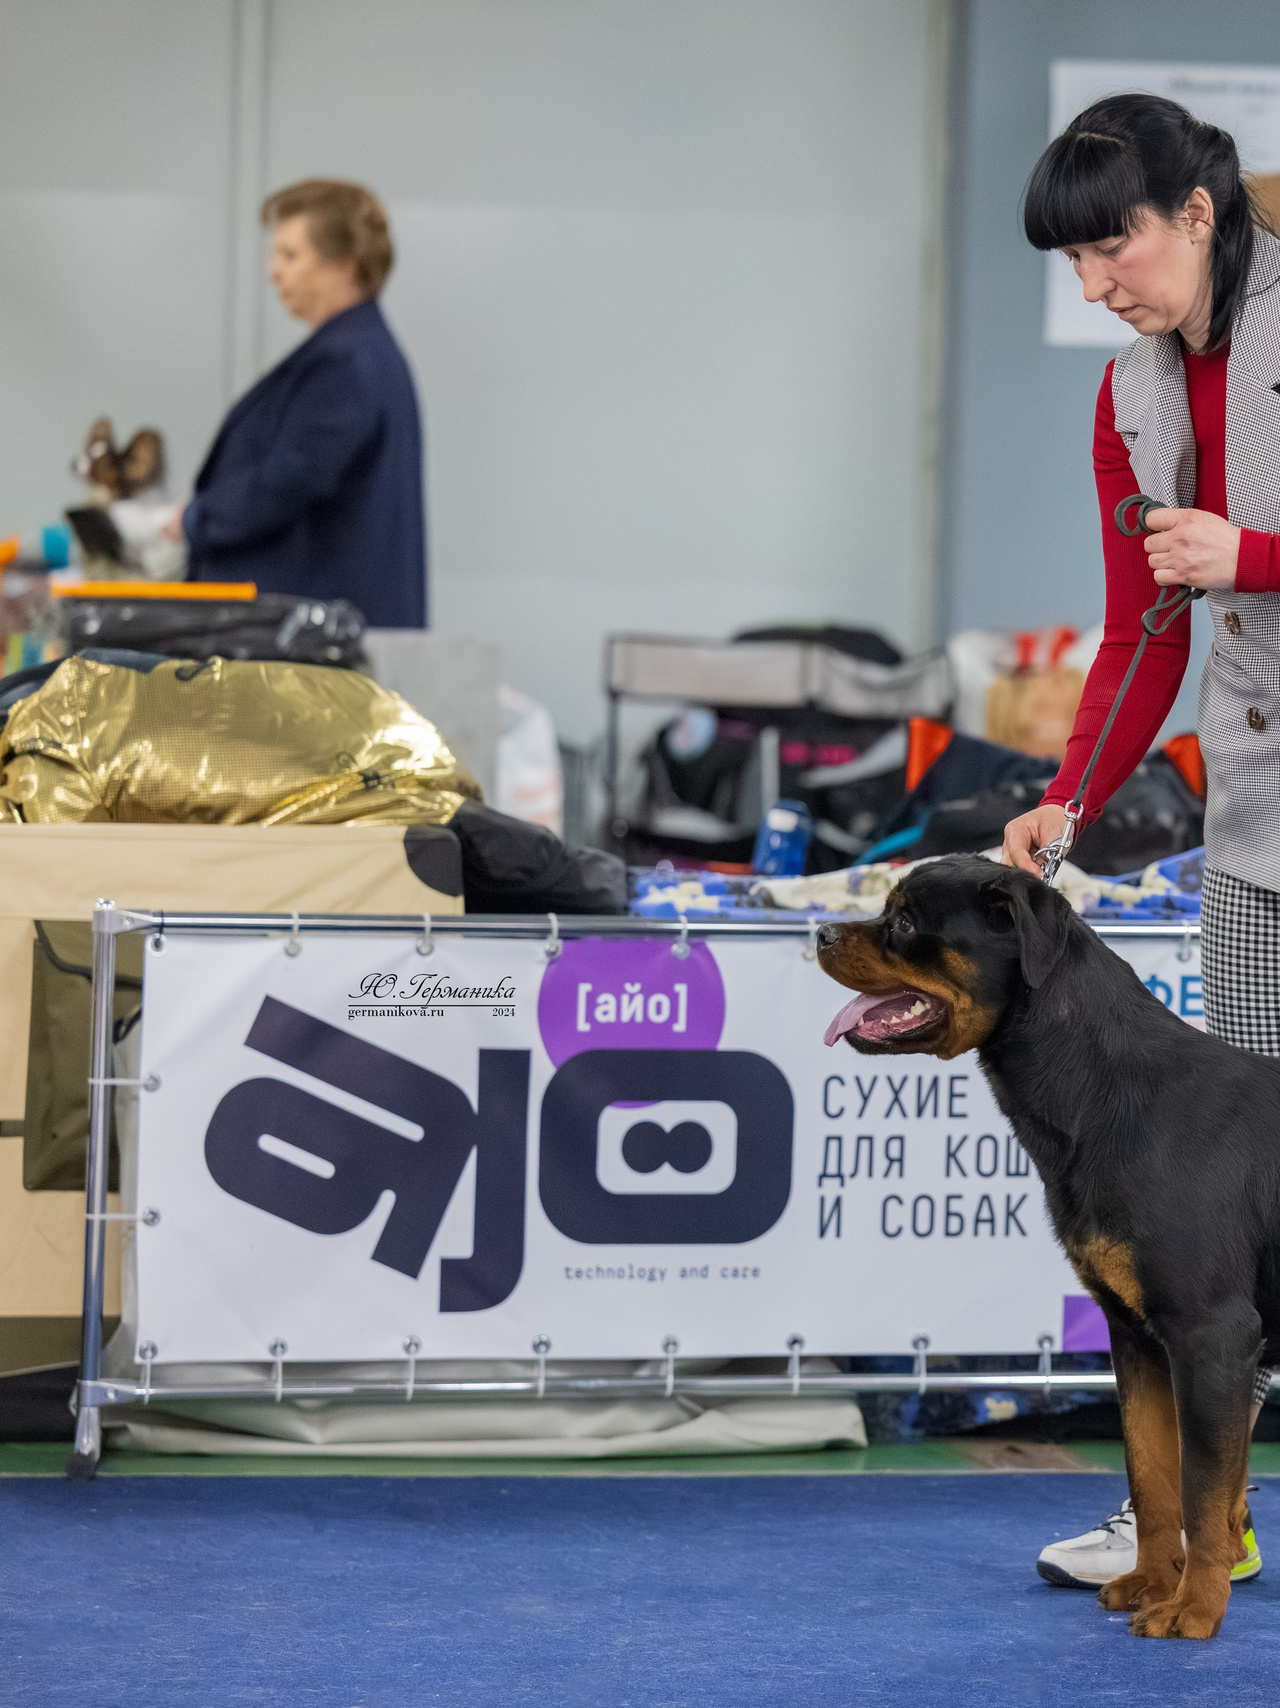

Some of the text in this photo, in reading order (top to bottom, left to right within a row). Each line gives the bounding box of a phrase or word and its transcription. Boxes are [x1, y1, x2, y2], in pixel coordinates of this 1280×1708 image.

[823, 1074, 970, 1119] СУХИЕ
[818, 1134, 905, 1188] ДЛЯ
[818, 1193, 1028, 1239] И СОБАК
[564, 1263, 762, 1282] technology and care
